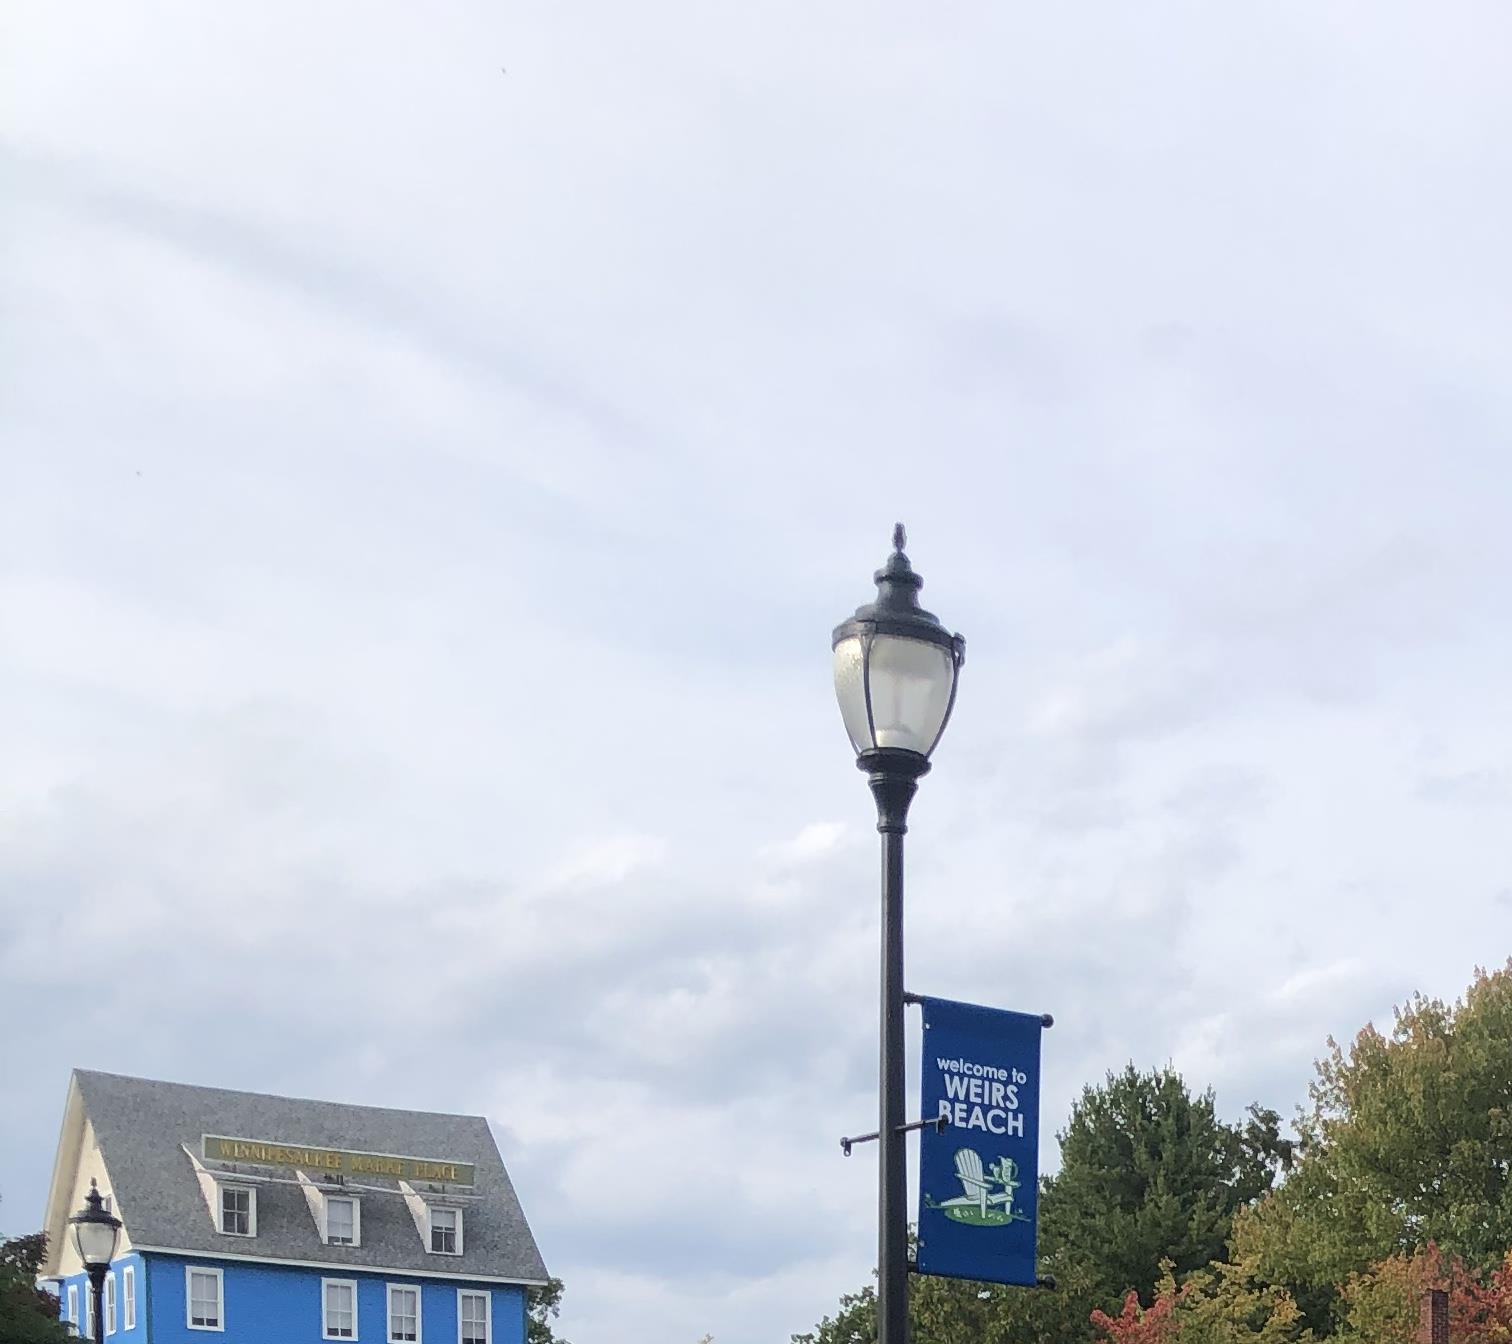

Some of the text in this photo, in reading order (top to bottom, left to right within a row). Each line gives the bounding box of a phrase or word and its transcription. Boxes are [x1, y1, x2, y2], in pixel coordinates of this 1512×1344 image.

[937, 1057, 1027, 1084] welcome to
[944, 1073, 1019, 1110] WEIRS
[938, 1099, 1024, 1137] BEACH
